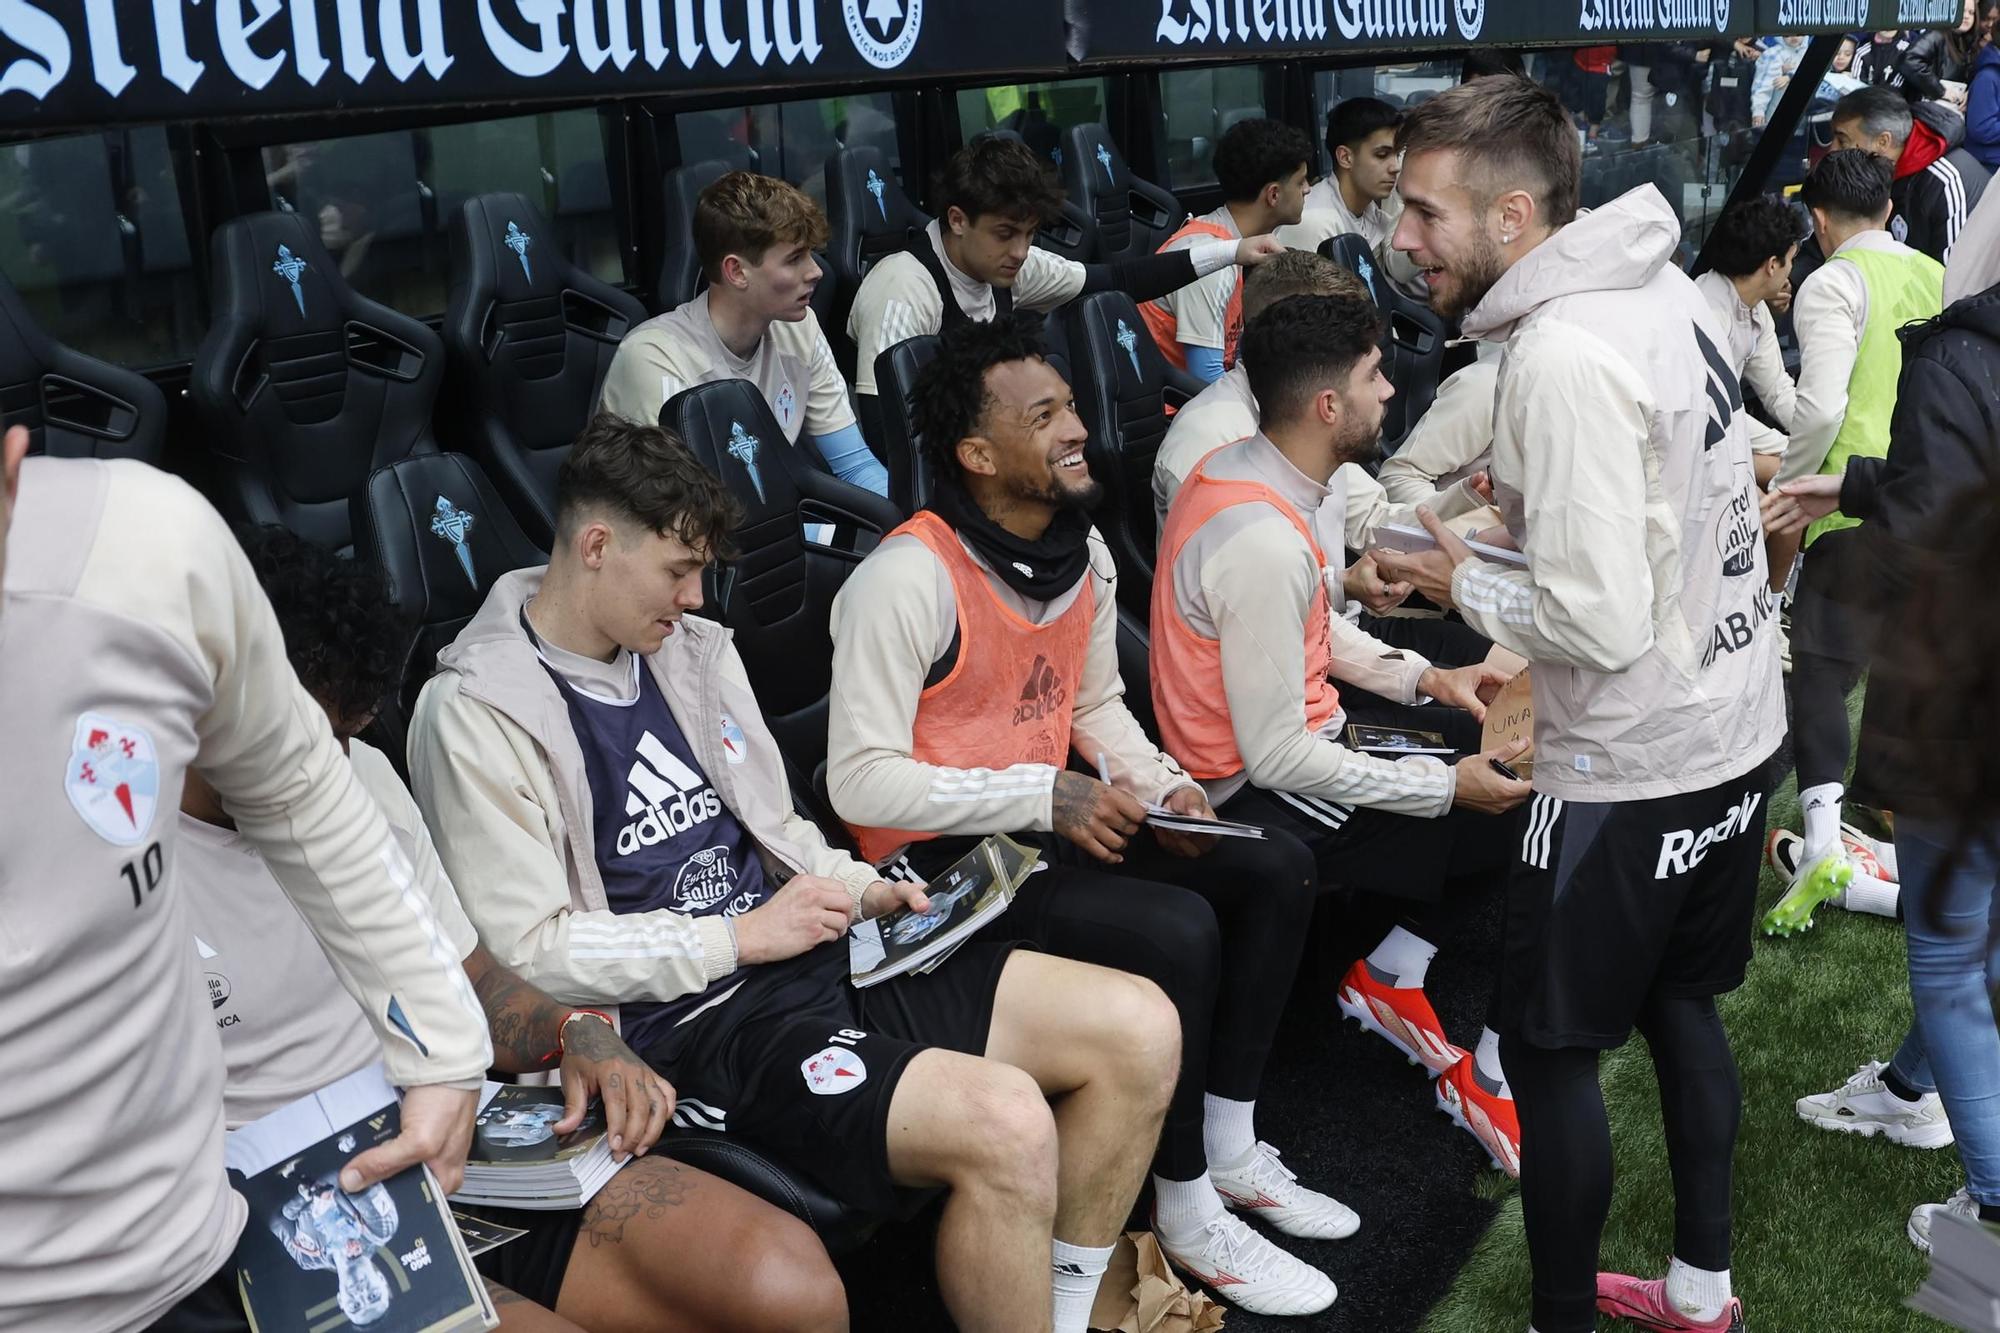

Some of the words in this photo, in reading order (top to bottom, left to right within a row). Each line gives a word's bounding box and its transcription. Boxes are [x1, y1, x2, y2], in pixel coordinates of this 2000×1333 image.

[616, 787, 721, 856] adidas
[120, 841, 163, 908] 10
[828, 1028, 867, 1046] 18
